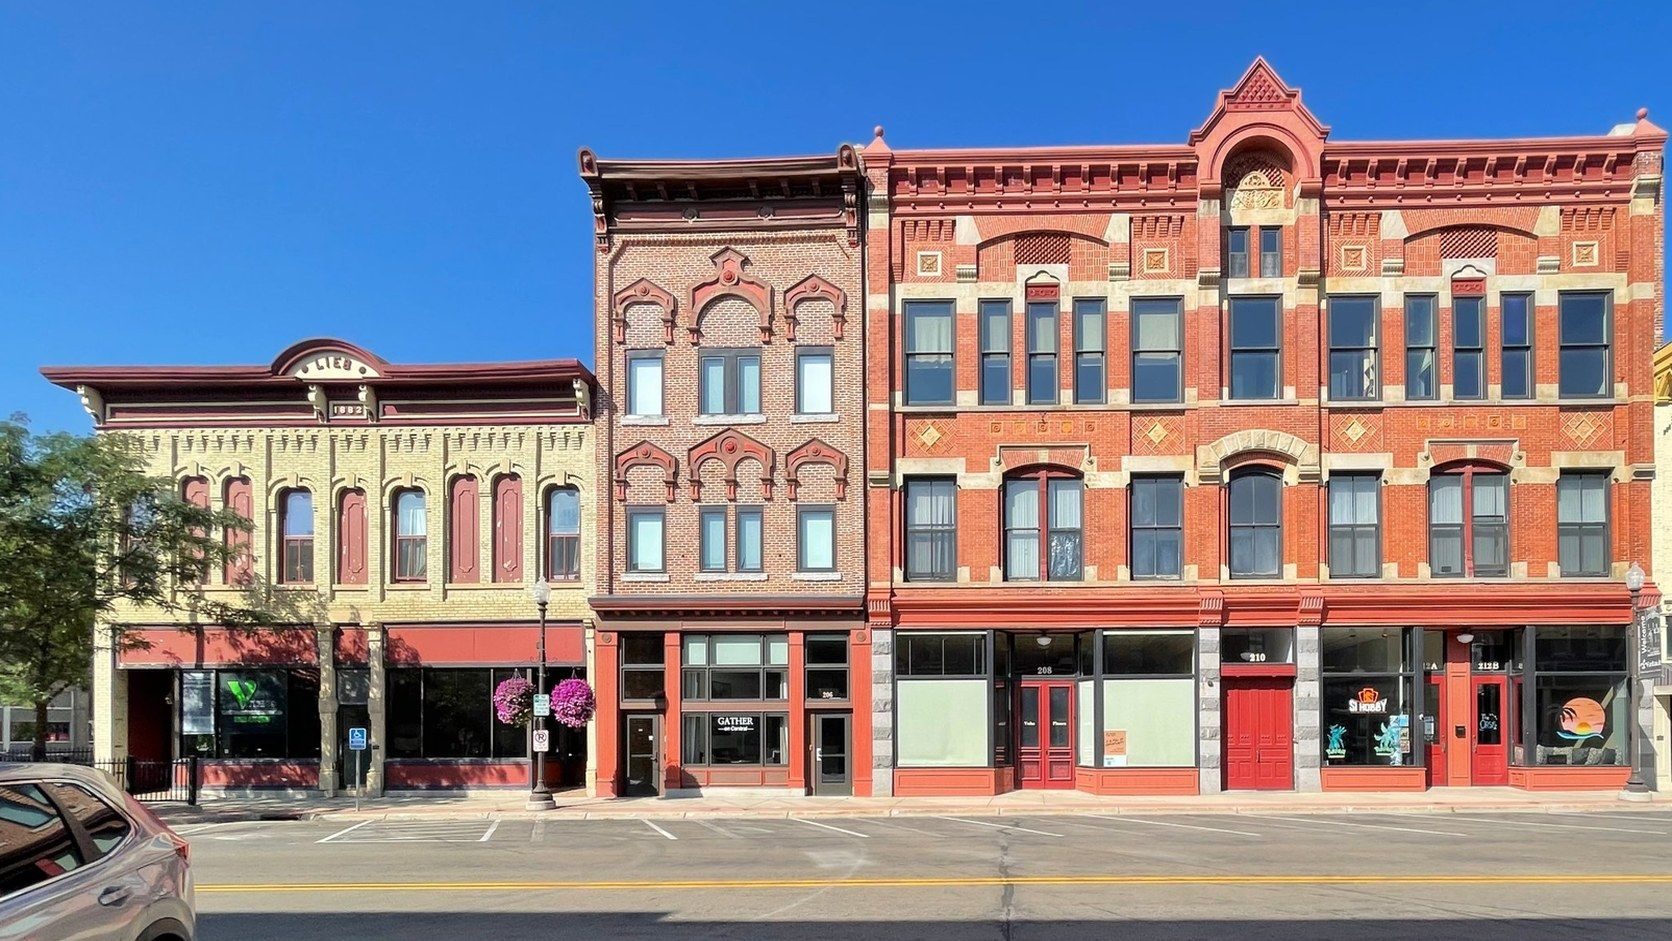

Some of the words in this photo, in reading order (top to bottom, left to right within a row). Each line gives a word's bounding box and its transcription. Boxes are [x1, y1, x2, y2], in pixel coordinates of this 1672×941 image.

[315, 356, 352, 371] LIEB
[334, 405, 362, 414] 1882
[1250, 652, 1266, 662] 210
[1037, 666, 1052, 674] 208
[1478, 662, 1499, 670] 212B
[717, 717, 753, 726] GATHER
